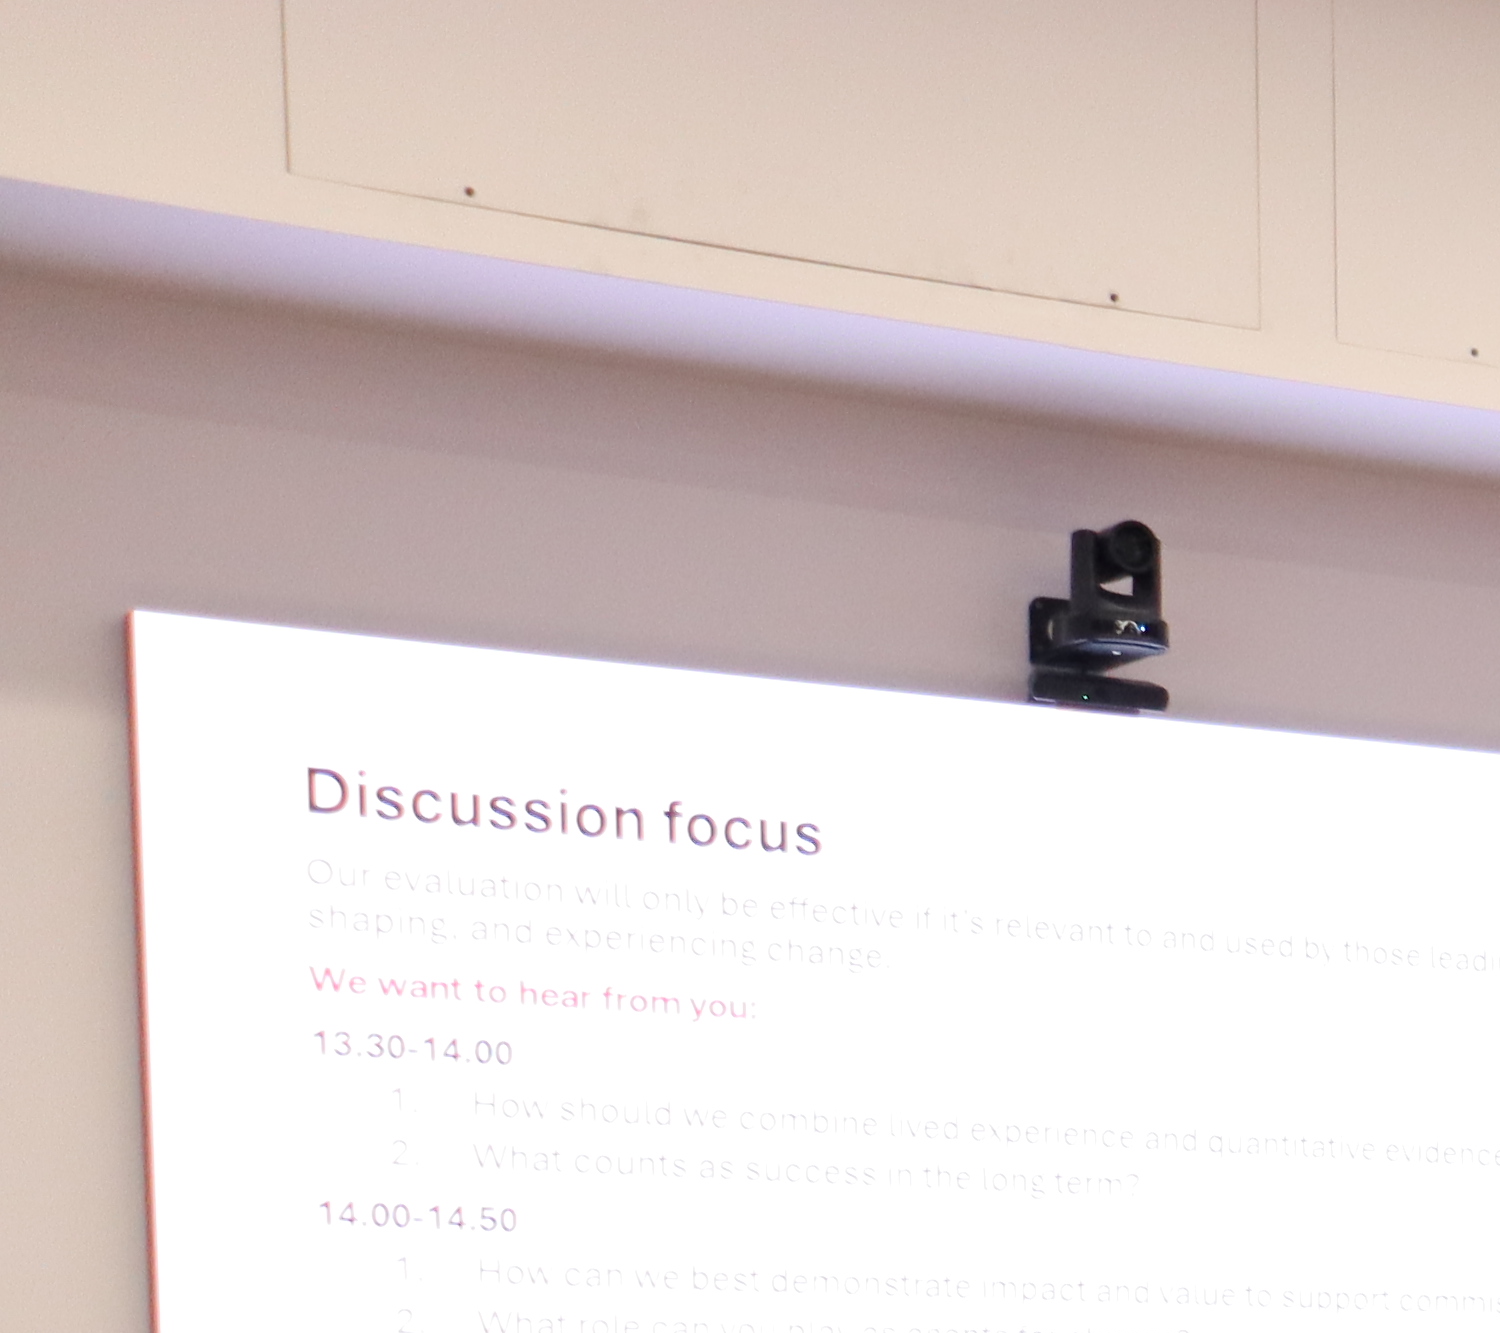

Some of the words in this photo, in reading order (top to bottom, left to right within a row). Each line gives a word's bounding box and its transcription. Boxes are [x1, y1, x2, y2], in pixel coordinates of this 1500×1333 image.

[306, 766, 645, 841] Discussion
[663, 800, 822, 856] focus
[308, 966, 367, 995] We
[377, 978, 462, 1001] want
[473, 979, 507, 1004] to
[519, 980, 590, 1009] hear
[601, 986, 681, 1014] from
[689, 998, 755, 1022] you:
[313, 1029, 513, 1066] 13.30-14.00
[319, 1200, 518, 1233] 14.00-14.50
